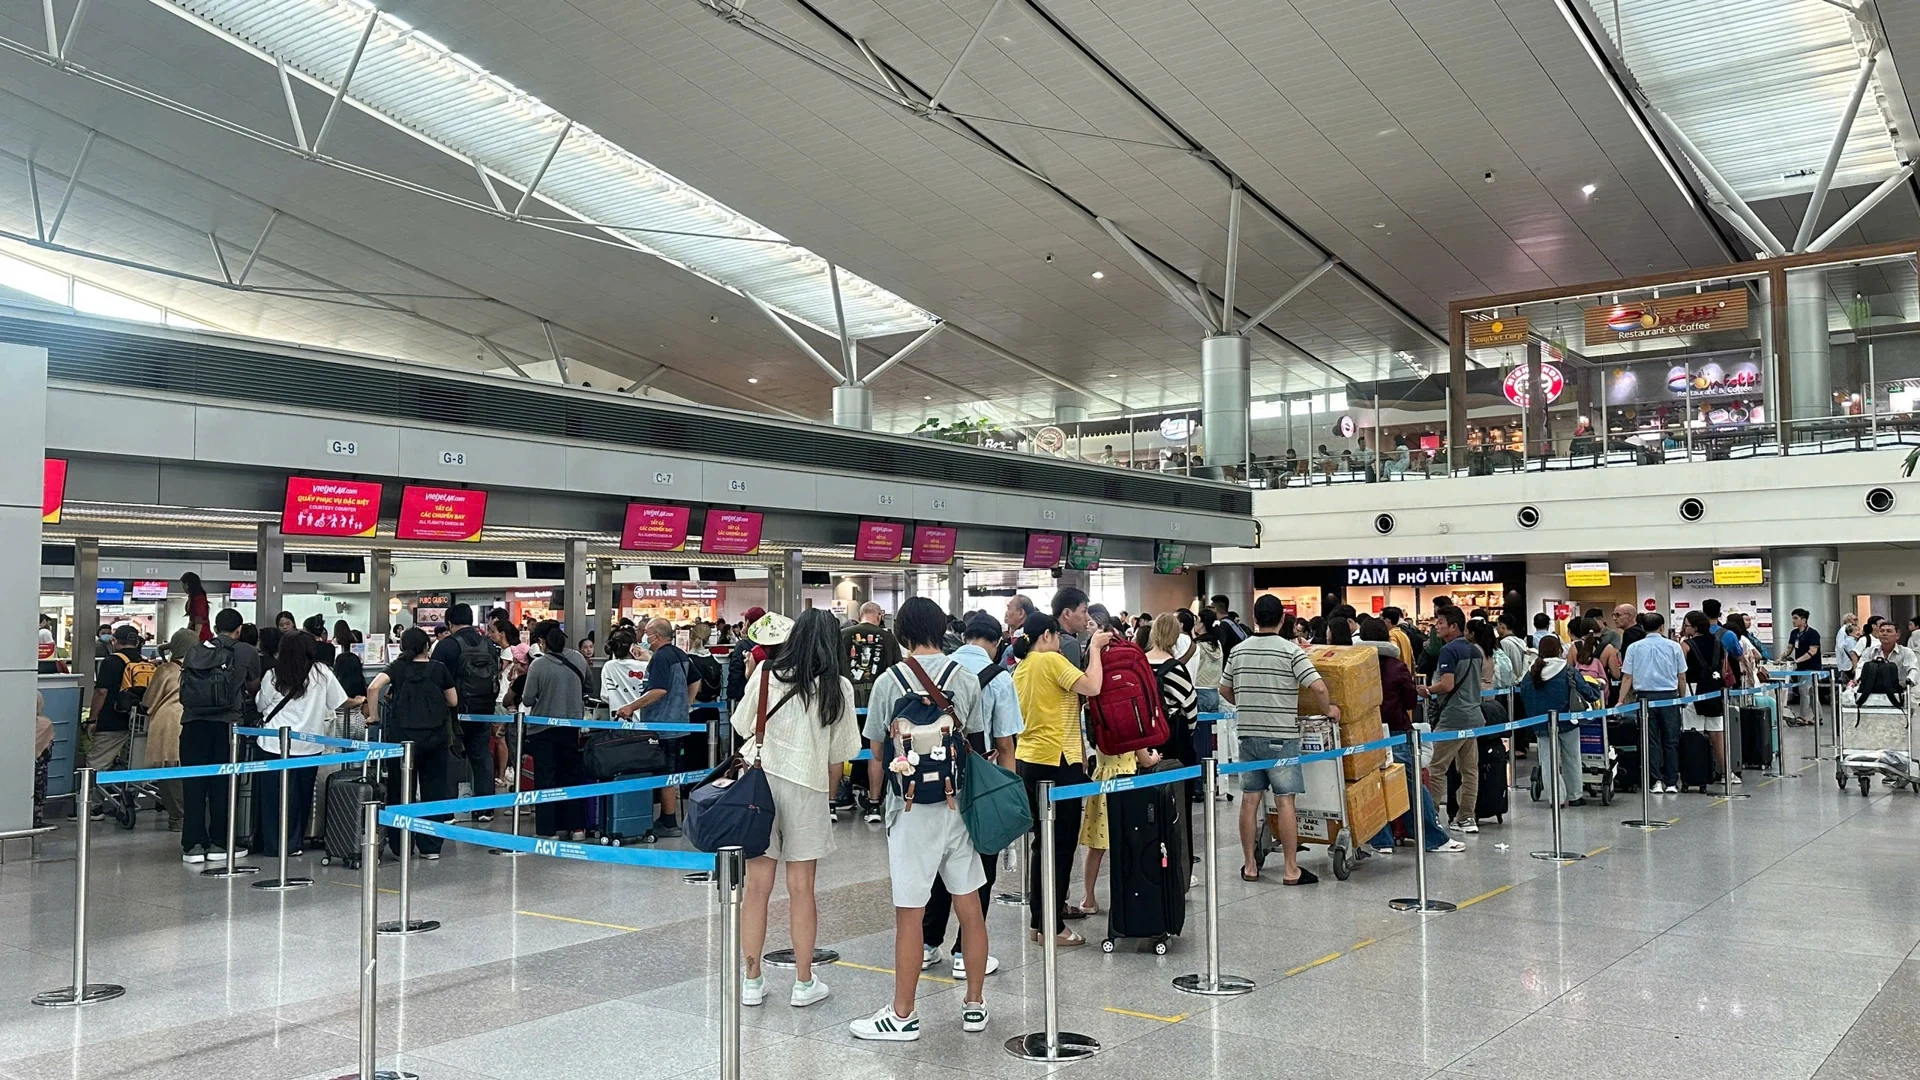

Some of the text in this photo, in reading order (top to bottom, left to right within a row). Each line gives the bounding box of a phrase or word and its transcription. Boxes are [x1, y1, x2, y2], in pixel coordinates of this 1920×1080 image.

[1618, 327, 1665, 339] Restaurant
[1680, 322, 1710, 332] Coffee
[1678, 388, 1716, 397] Retaurant
[332, 441, 354, 454] G-9
[444, 452, 464, 464] G-8
[656, 474, 672, 483] G-7
[732, 480, 746, 490] G-6
[880, 495, 892, 504] G-5
[934, 500, 944, 508] G-4
[1348, 568, 1494, 584] PAM PHỞ VIỆT NAM
[366, 749, 386, 759] ACV
[1274, 758, 1288, 767] ACV
[218, 764, 243, 774] ACV
[666, 773, 686, 785] ACV
[1100, 780, 1115, 793] ACV
[514, 791, 540, 804] ACV
[393, 814, 412, 829] ACV
[535, 840, 557, 856] ACV
